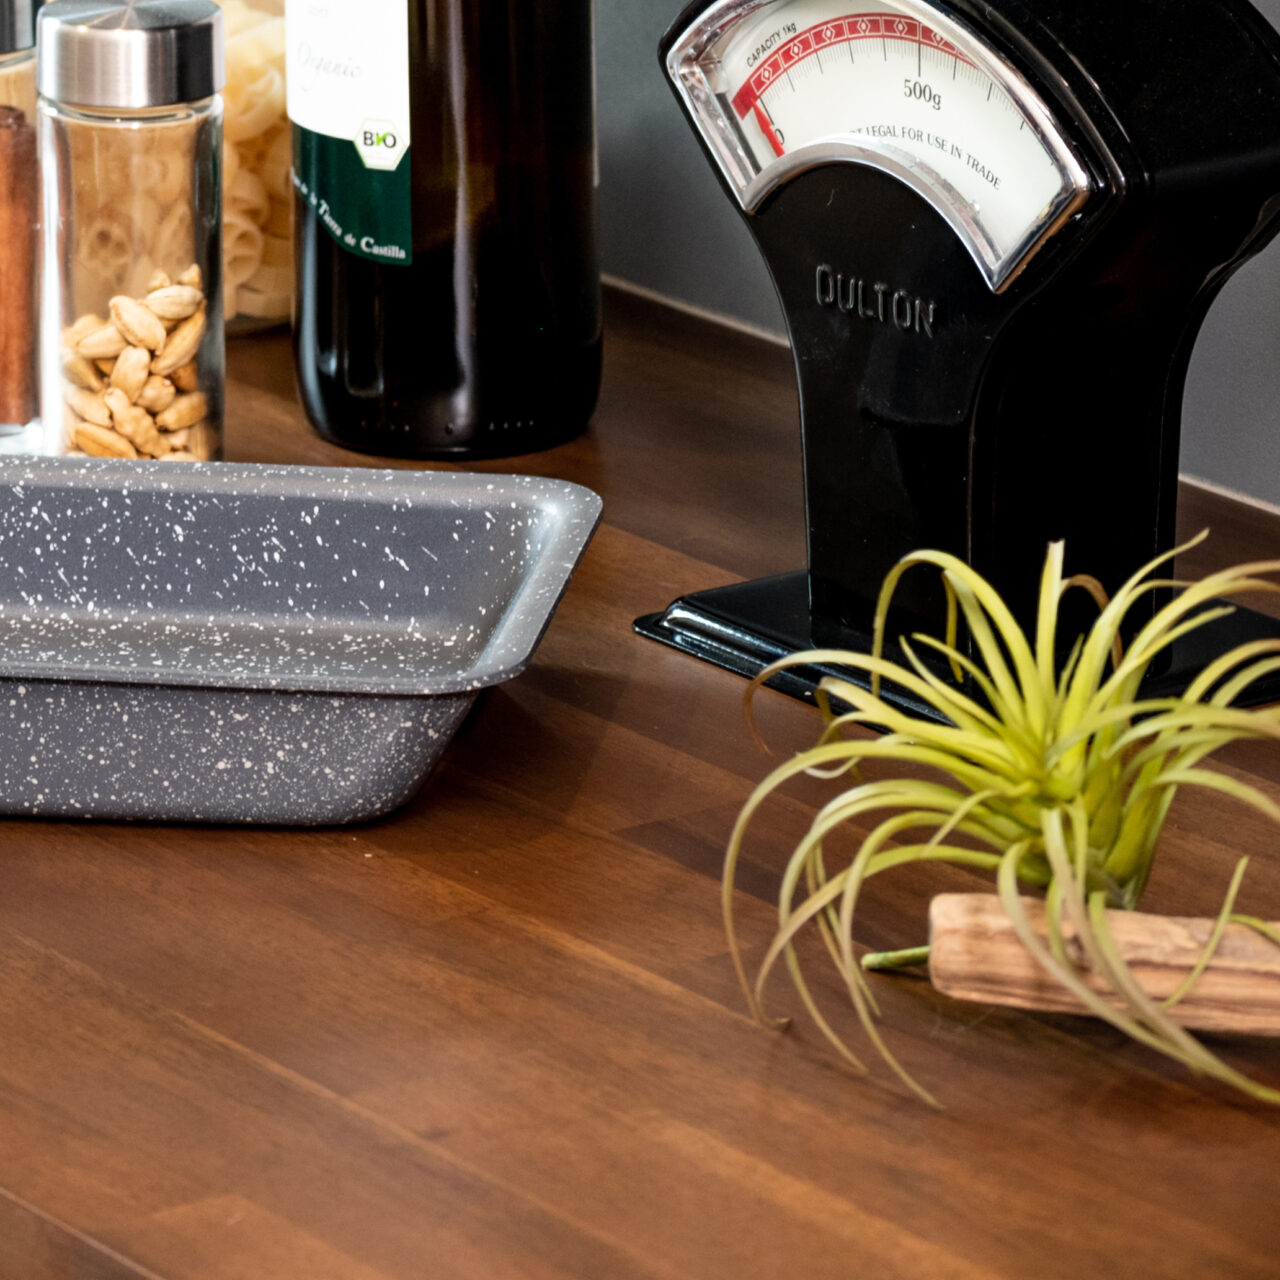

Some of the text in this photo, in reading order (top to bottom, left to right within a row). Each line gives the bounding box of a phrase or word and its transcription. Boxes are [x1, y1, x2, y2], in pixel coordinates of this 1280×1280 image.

[746, 22, 798, 68] CAPACITY 1kg
[903, 78, 942, 111] 500g
[363, 131, 398, 149] BIO
[901, 125, 924, 142] FOR
[927, 135, 949, 152] USE
[950, 144, 963, 160] IN
[966, 152, 1003, 191] TRADE
[360, 236, 406, 259] Castilla
